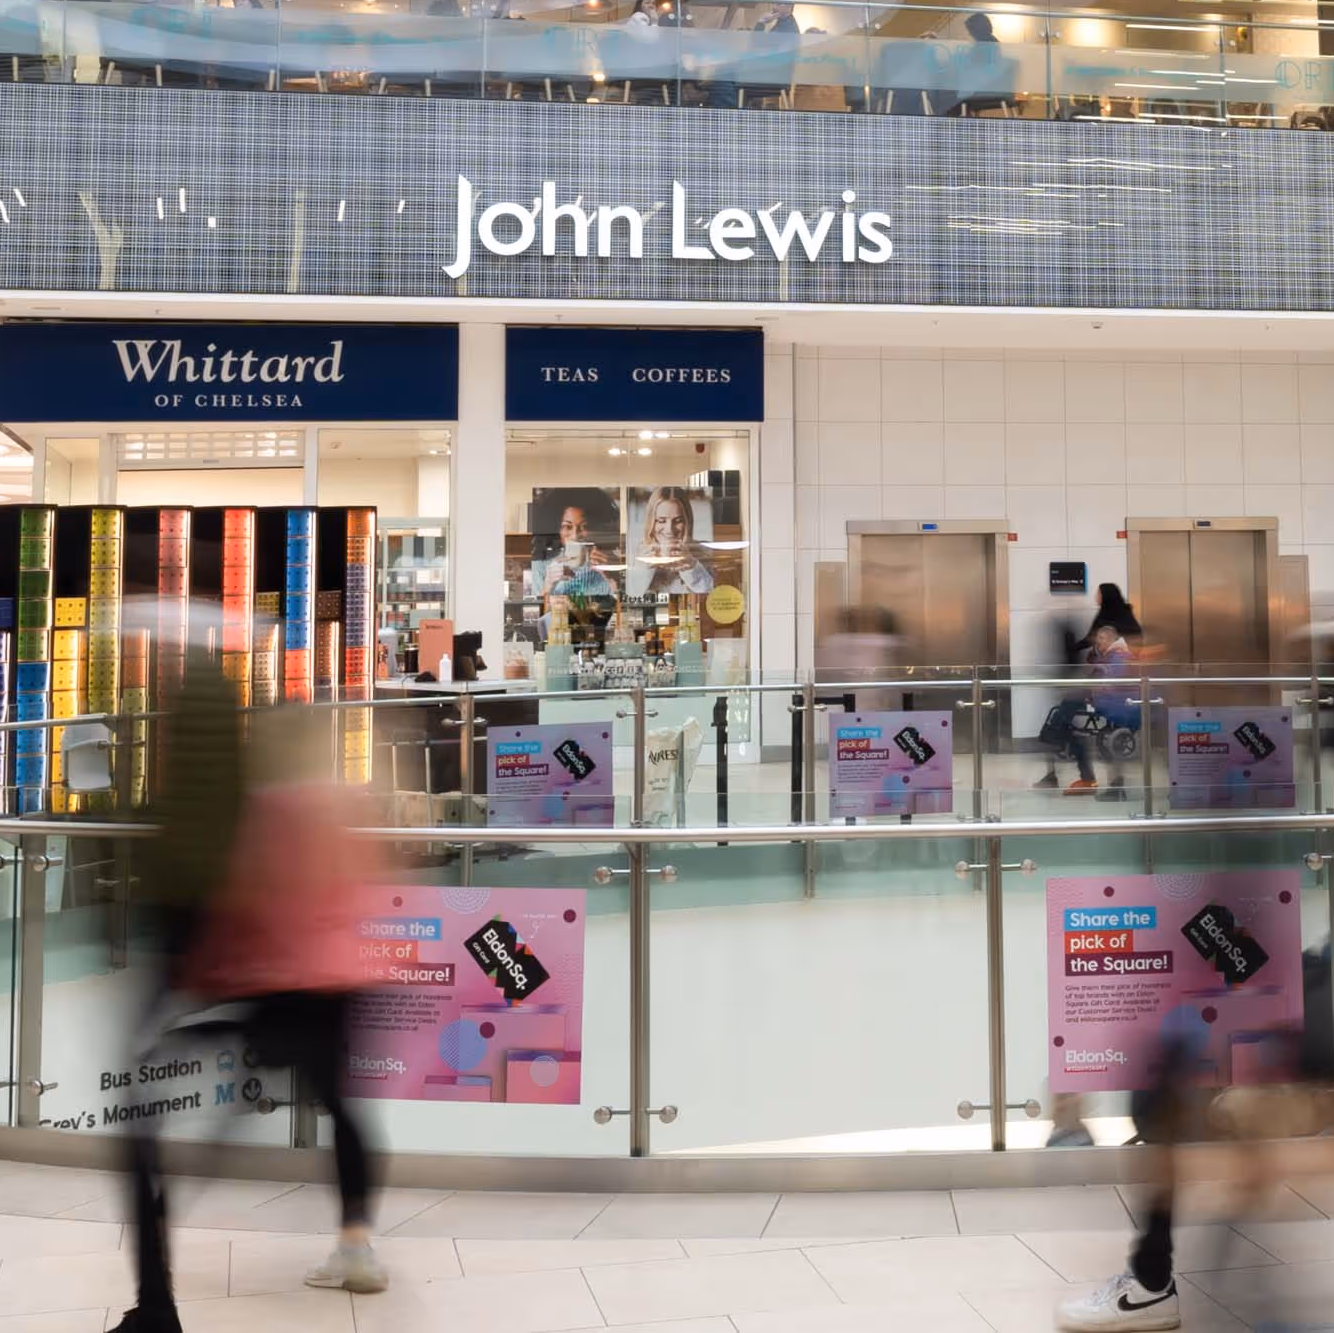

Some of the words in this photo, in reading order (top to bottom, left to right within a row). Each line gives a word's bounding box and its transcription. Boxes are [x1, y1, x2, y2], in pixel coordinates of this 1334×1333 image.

[442, 174, 645, 280] John
[672, 181, 894, 264] Lewis
[112, 339, 346, 383] Whittard
[541, 367, 599, 382] TEAS
[631, 368, 732, 384] COFFEES
[154, 394, 184, 407] OF
[194, 394, 303, 407] CHELSEA
[841, 728, 864, 737] Share
[865, 728, 879, 736] the
[498, 745, 523, 754] Share
[524, 744, 540, 753] the
[839, 740, 857, 750] pick
[859, 739, 868, 747] of
[498, 756, 516, 766] pick
[516, 755, 527, 764] of
[839, 751, 854, 759] the
[855, 750, 888, 761] Square!
[498, 767, 514, 777] the
[514, 766, 547, 778] Square!
[1069, 911, 1119, 928] Share
[1123, 911, 1151, 926] the
[360, 921, 406, 936] Share
[409, 920, 436, 937] the
[395, 944, 412, 958] of
[1069, 935, 1105, 953] pick
[1109, 933, 1128, 949] of
[1199, 913, 1248, 974] EldonSq.
[482, 927, 528, 991] EldonSq.
[1070, 957, 1099, 972] the
[1103, 955, 1168, 975] Square!
[387, 966, 450, 984] Square!
[1065, 1000, 1088, 1008] Square
[1078, 1007, 1110, 1015] Customer
[1065, 1048, 1128, 1065] EldonSq.
[100, 1070, 132, 1092] Bus
[138, 1059, 203, 1084] Station
[103, 1091, 202, 1125] Monument
